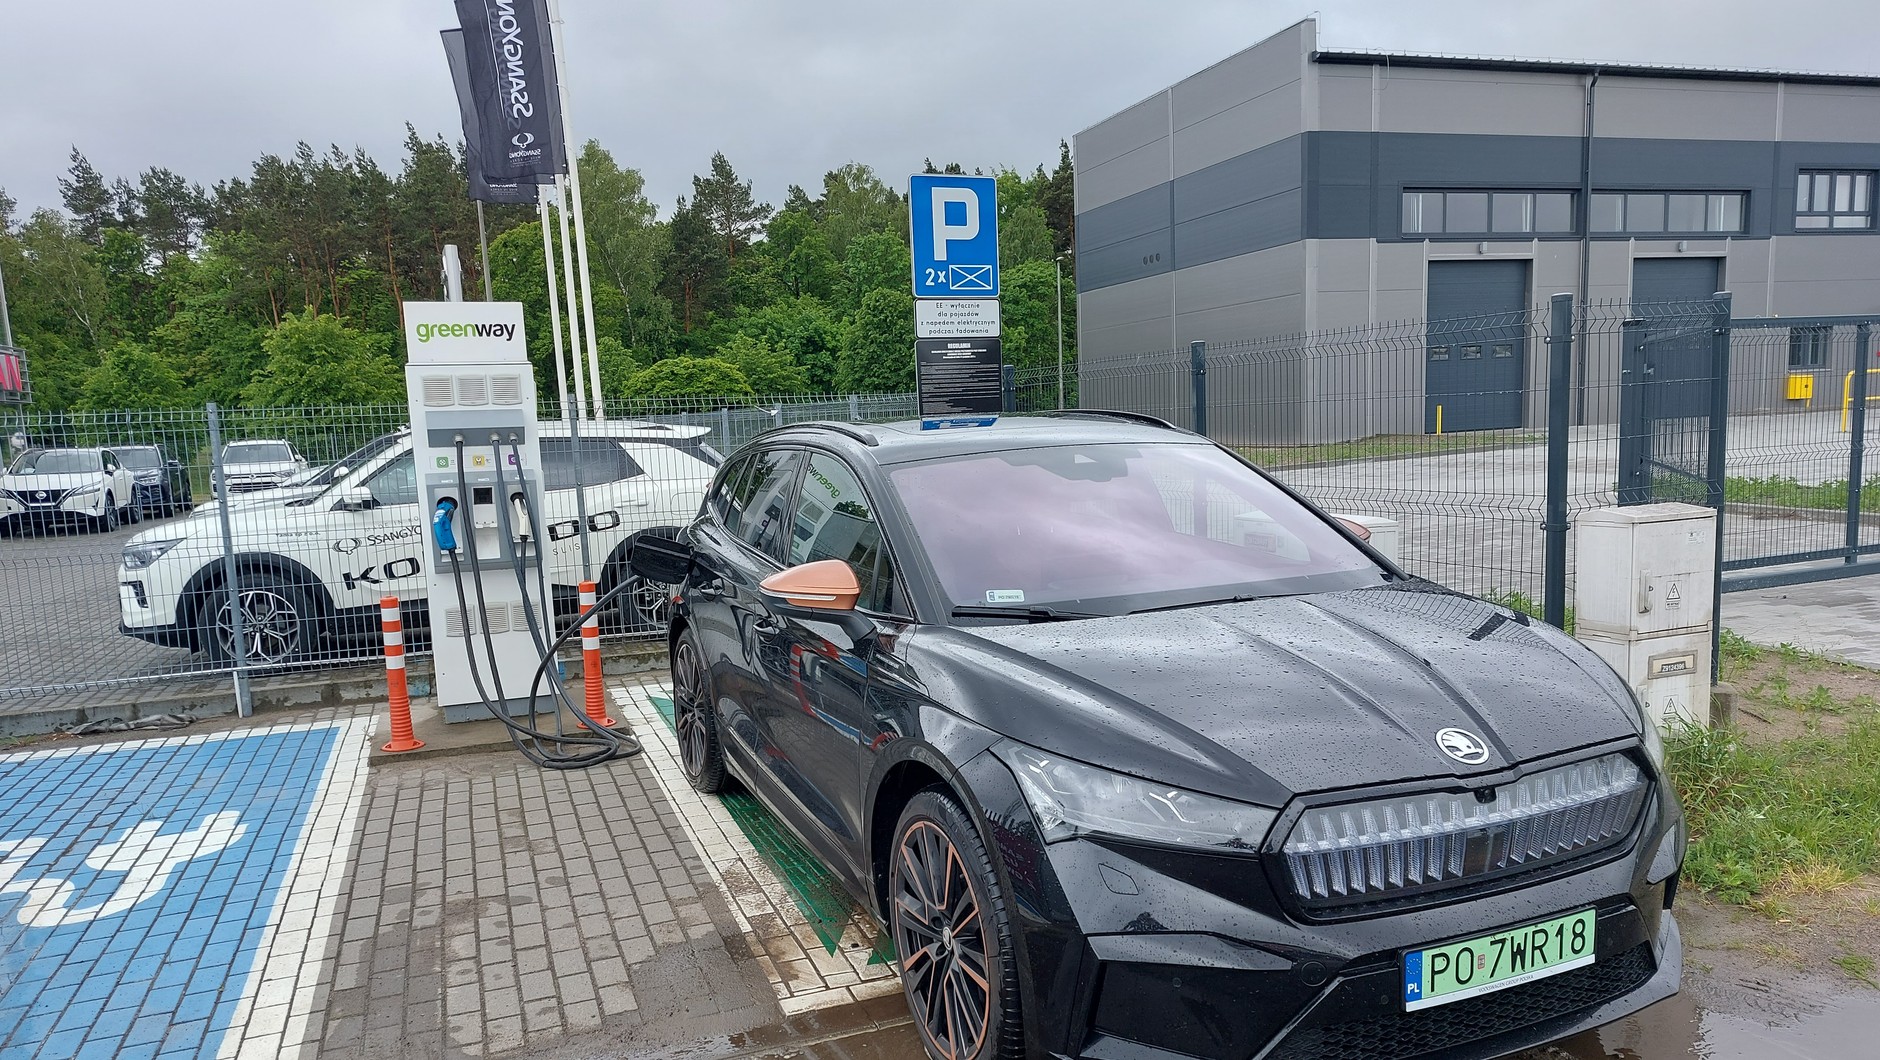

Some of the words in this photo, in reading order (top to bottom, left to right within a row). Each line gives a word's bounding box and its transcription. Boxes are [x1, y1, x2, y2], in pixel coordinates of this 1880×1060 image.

[931, 186, 980, 261] P
[950, 302, 980, 310] wyłącznie
[957, 319, 996, 327] elektrycznym
[416, 323, 515, 343] greenway
[1430, 947, 1475, 993] PO
[1488, 918, 1586, 979] 7WR18
[1407, 983, 1420, 995] PL
